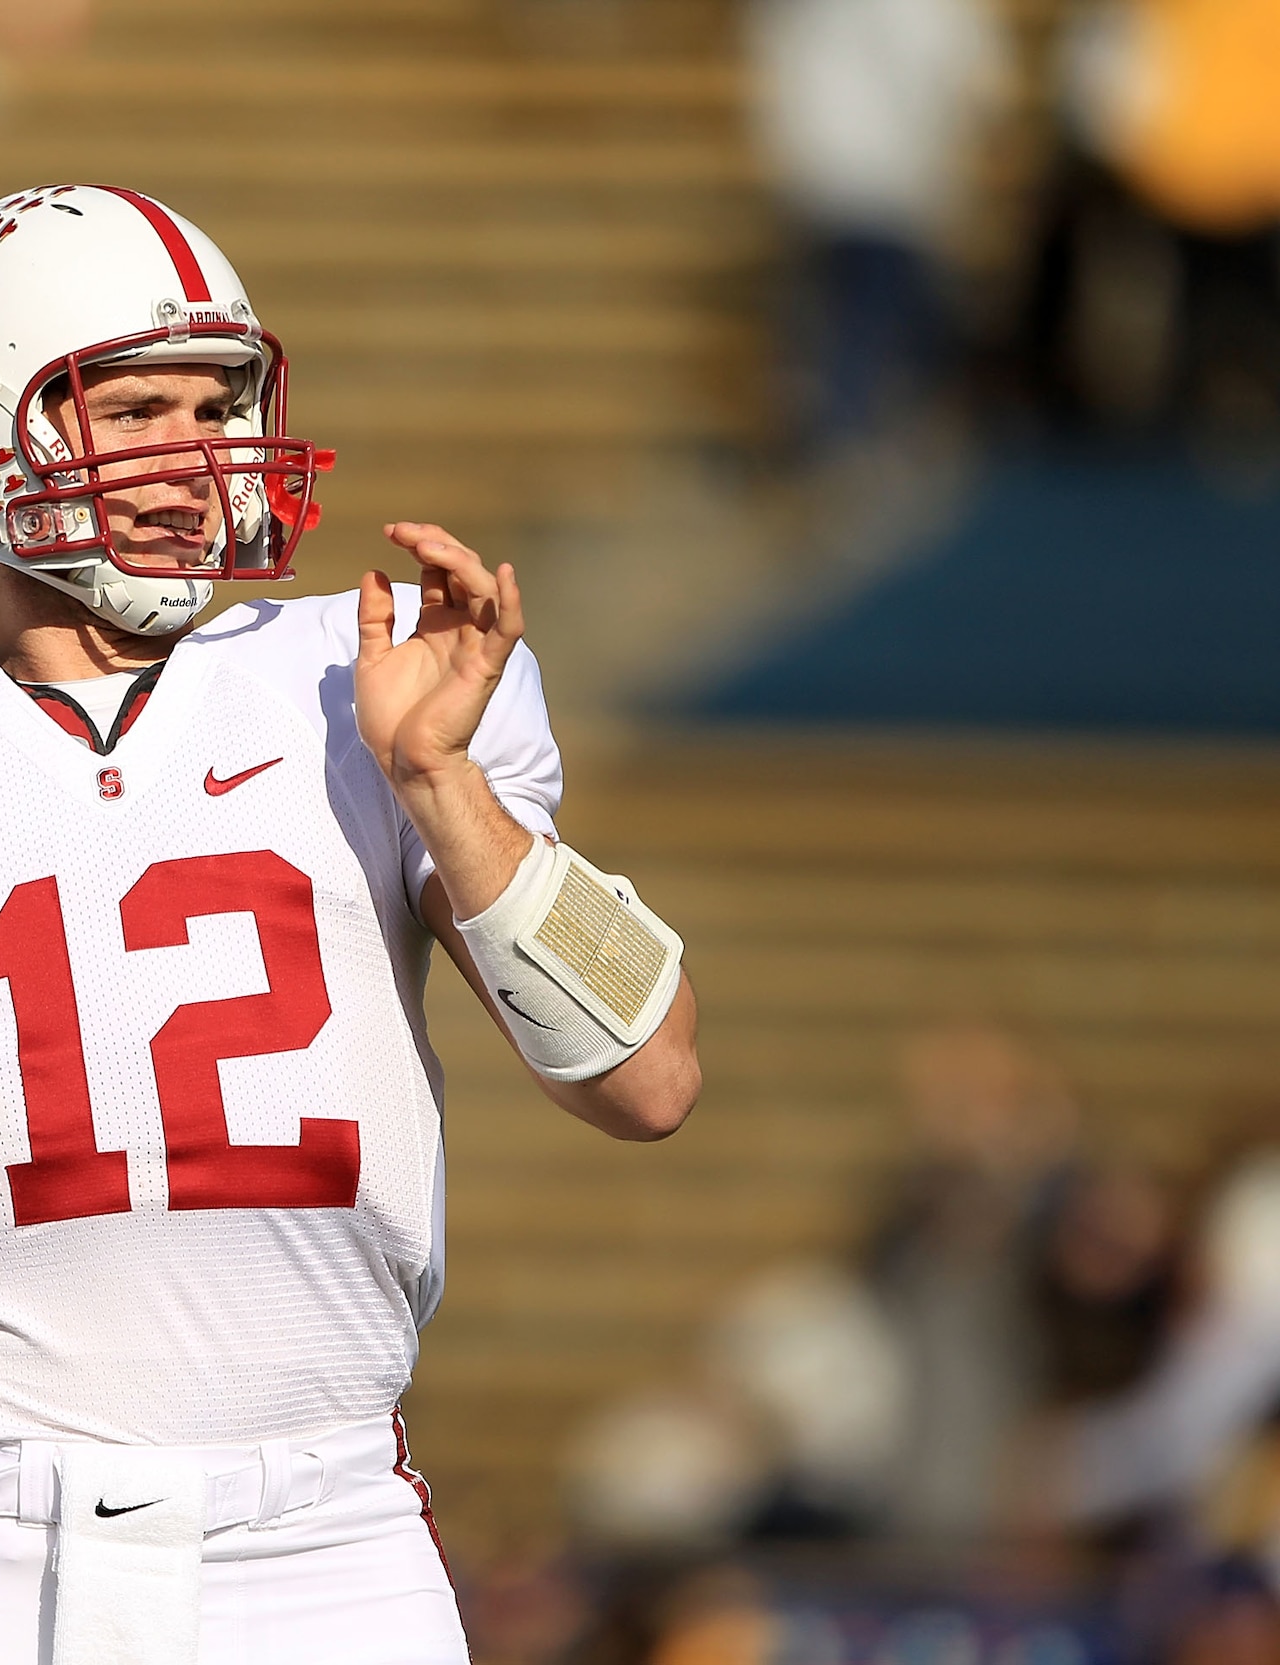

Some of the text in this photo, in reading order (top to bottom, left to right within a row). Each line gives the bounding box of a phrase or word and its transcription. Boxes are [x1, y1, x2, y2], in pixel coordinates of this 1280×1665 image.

[182, 311, 233, 323] ARDINA
[160, 596, 197, 607] Riddell
[96, 766, 125, 801] S
